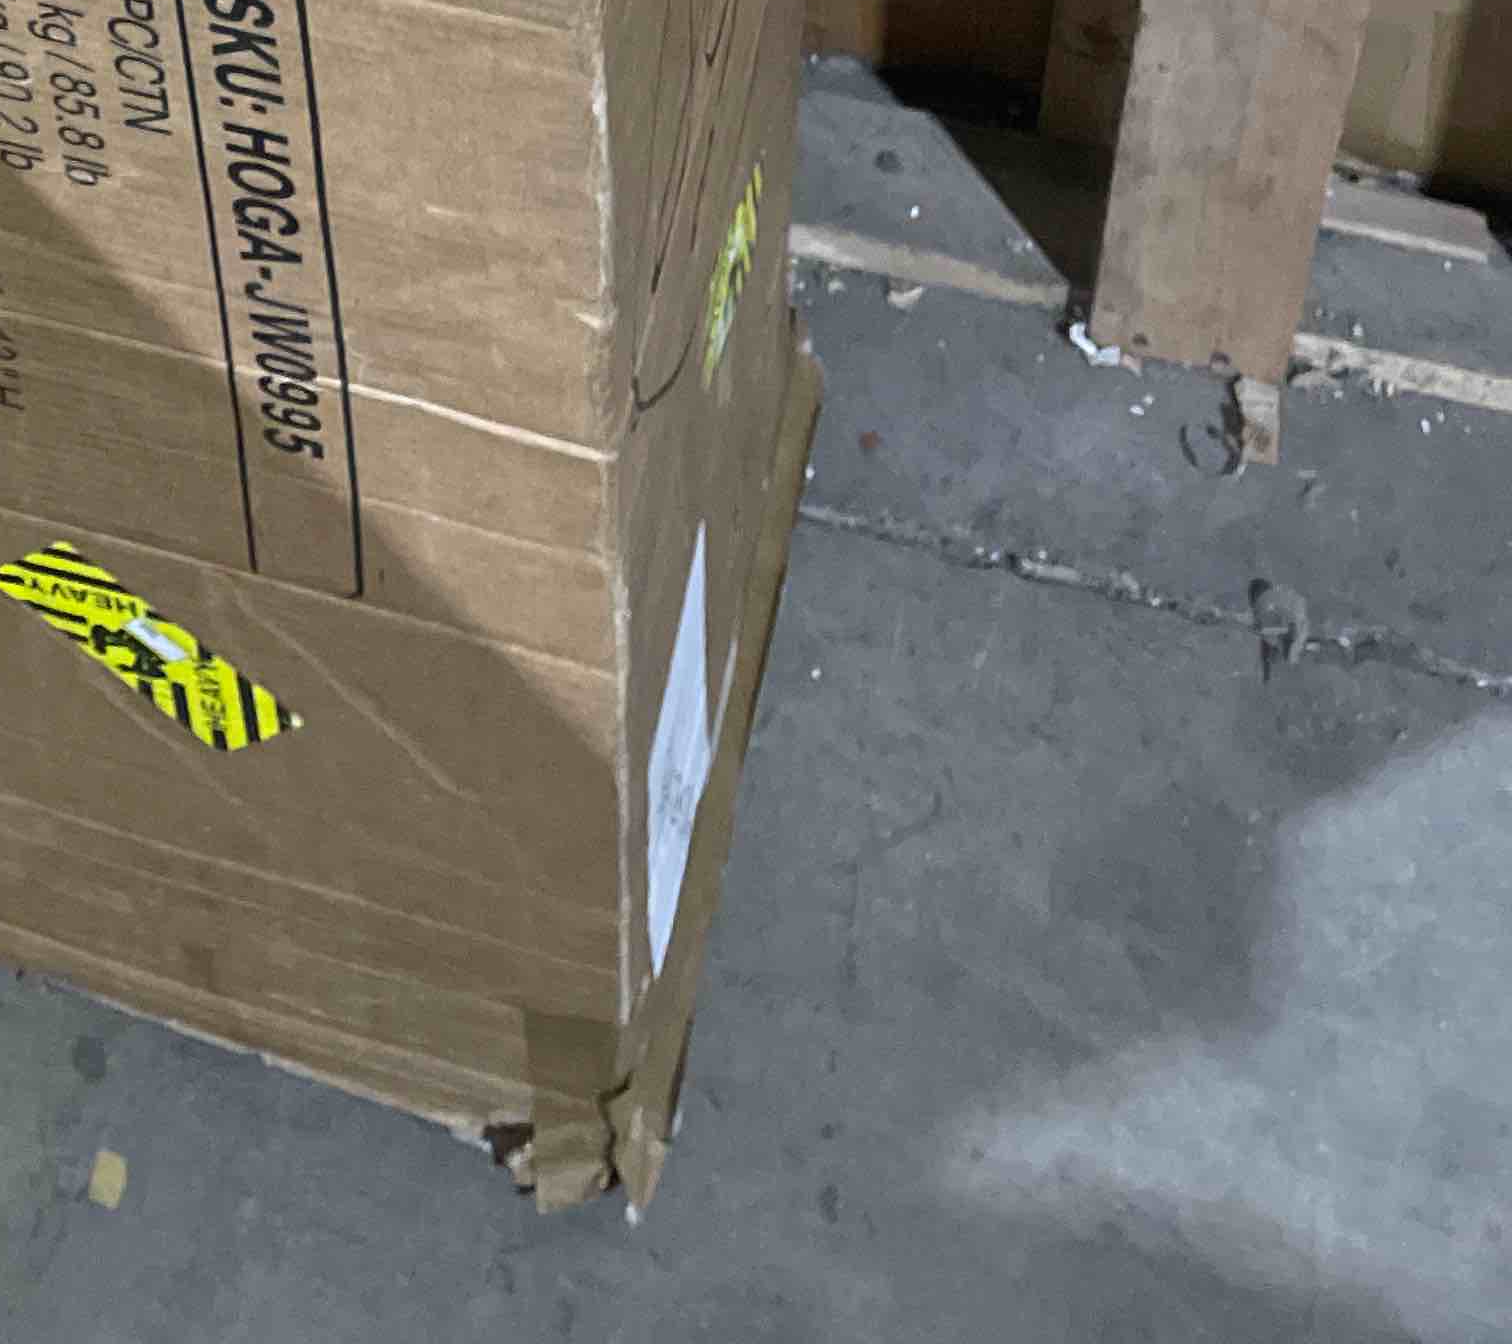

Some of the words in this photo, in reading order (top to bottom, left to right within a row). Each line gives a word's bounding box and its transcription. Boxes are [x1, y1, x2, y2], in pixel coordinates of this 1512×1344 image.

[27, 0, 85, 49] kg
[48, 71, 106, 151] 85.8
[62, 154, 114, 188] lb
[221, 121, 325, 463] HOGA-JW0995
[30, 576, 139, 618] HEAVY
